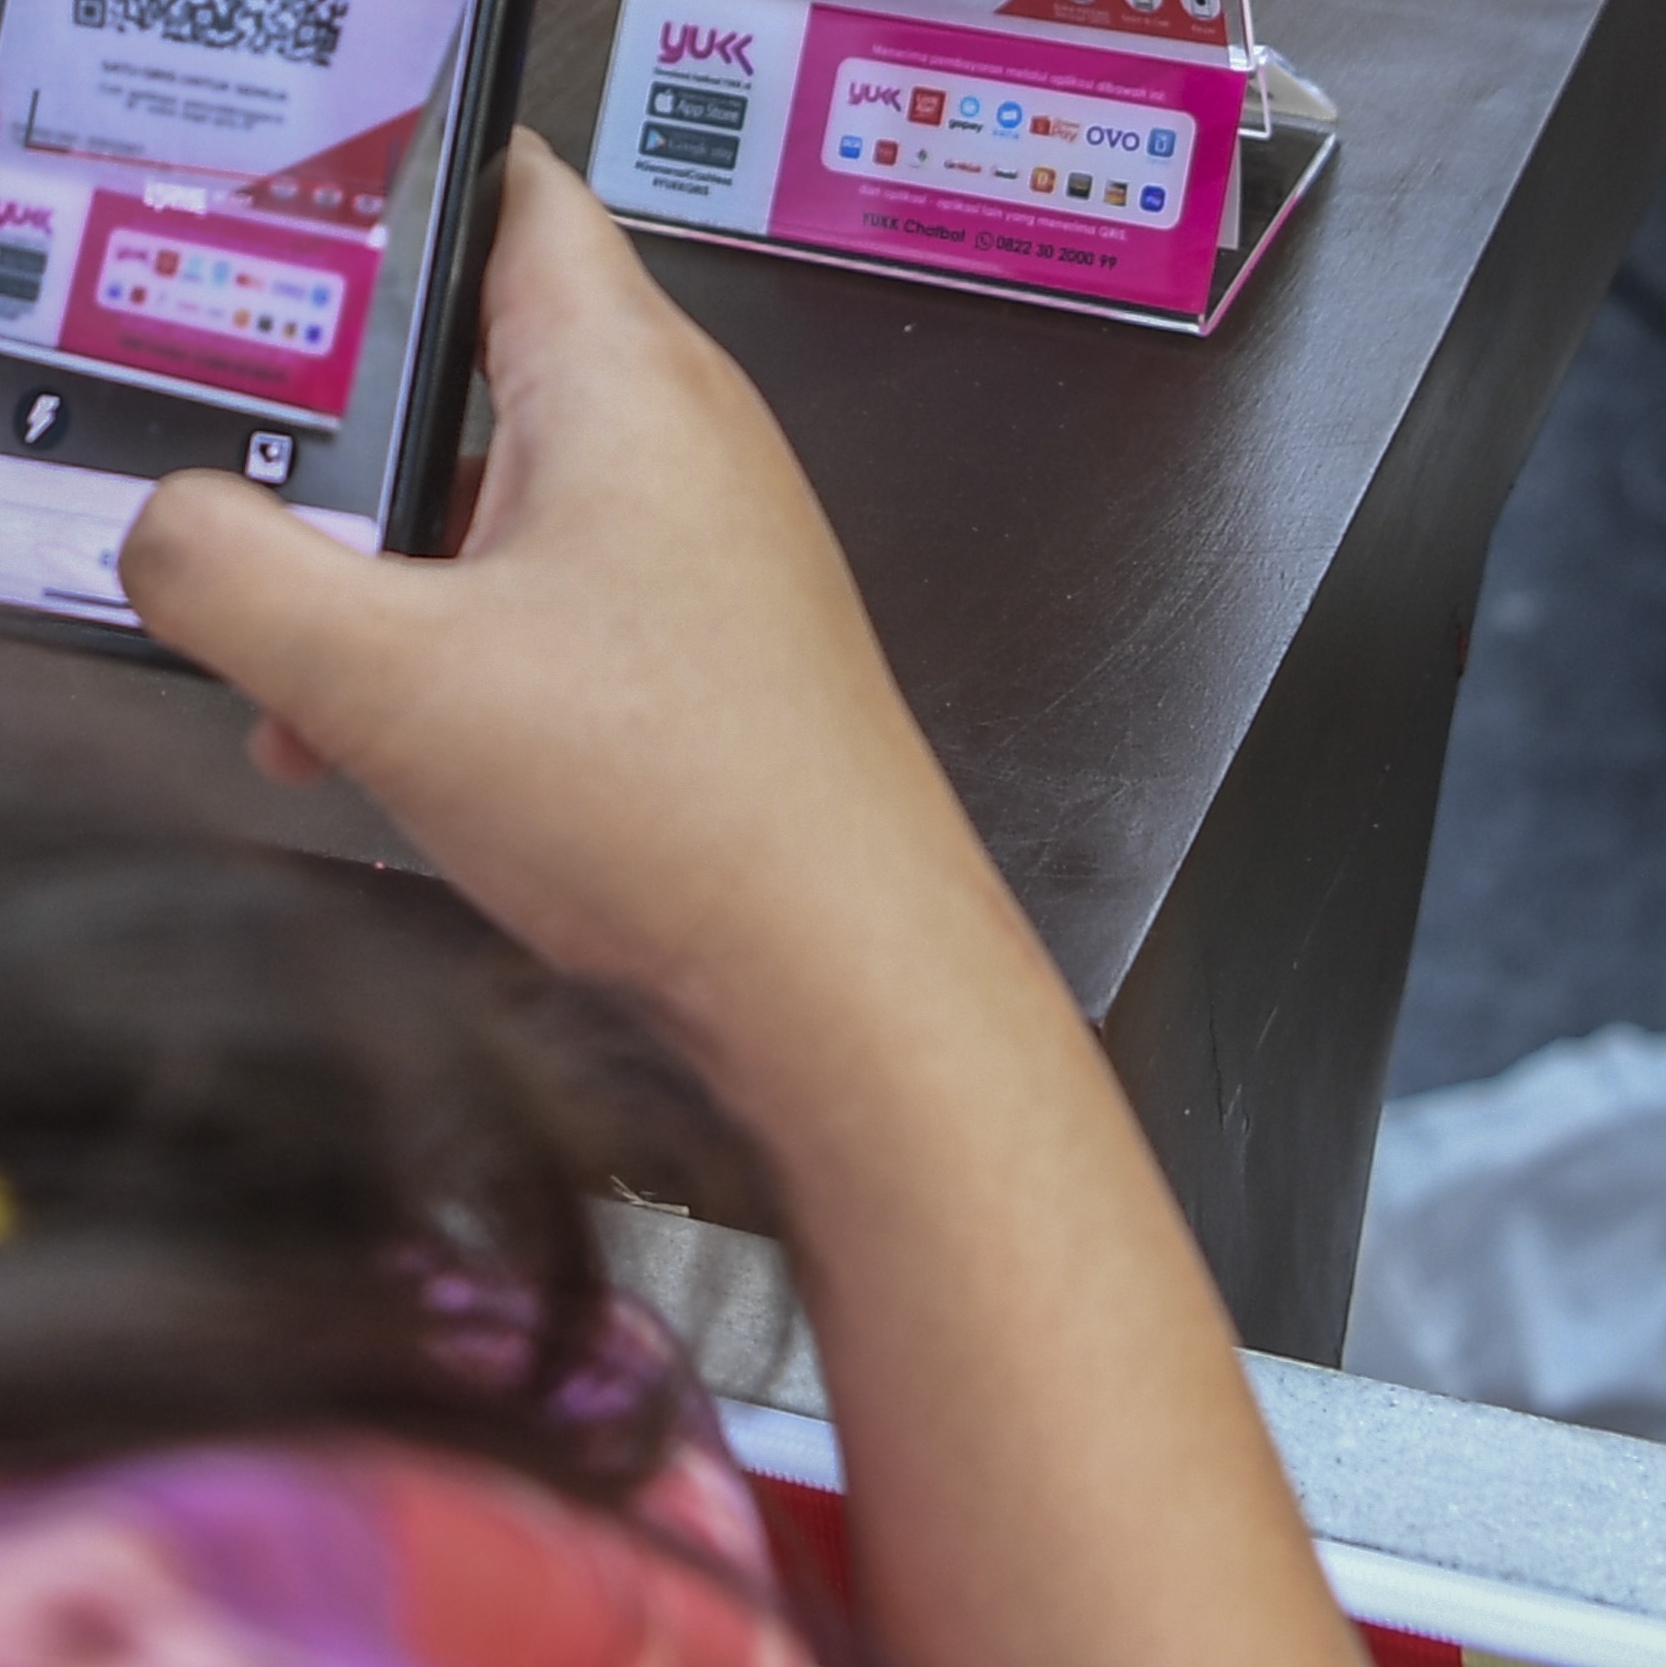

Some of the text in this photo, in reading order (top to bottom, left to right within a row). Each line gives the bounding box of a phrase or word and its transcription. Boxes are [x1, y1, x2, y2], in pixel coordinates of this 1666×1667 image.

[1086, 126, 1140, 151] OVO
[996, 237, 1032, 255] 0822
[1036, 243, 1054, 259] 30
[1058, 247, 1094, 266] 2000
